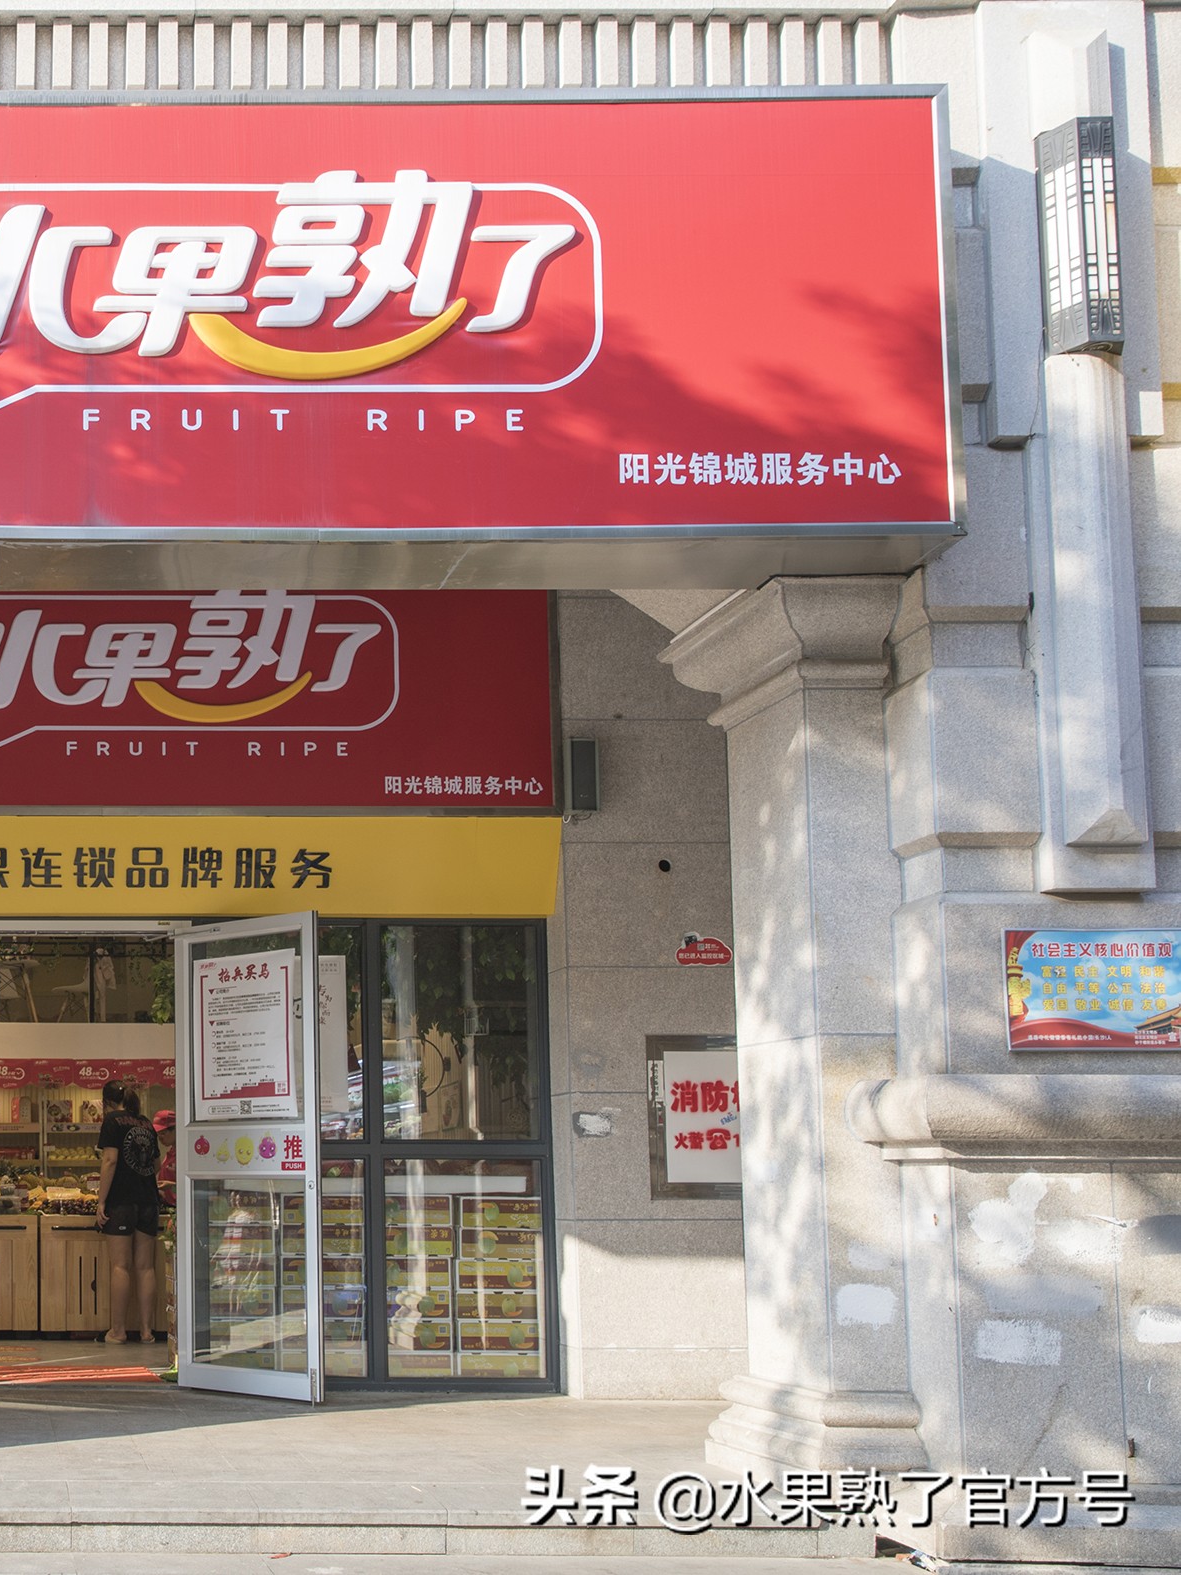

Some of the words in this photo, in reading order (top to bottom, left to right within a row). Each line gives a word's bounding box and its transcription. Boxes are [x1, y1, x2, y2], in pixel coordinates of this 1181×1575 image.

[82, 408, 290, 432] FRUIT
[367, 408, 525, 432] RIPE
[619, 452, 902, 486] 阳光锦城服务中心
[66, 740, 199, 757] FRUIT
[247, 740, 349, 757] RIPE
[384, 775, 543, 797] 阳光锦城服务中心
[1031, 942, 1172, 958] 社会主义核心价值观
[217, 963, 270, 984] 招兵买马
[1074, 965, 1099, 978] 民主
[1107, 966, 1132, 978] 文明
[1139, 965, 1165, 978] 和谐
[1042, 982, 1067, 995] 自由
[1074, 982, 1100, 995] 平等
[1107, 982, 1134, 995] 公正
[1140, 982, 1166, 995] 法治
[1043, 998, 1068, 1011] 爱国
[1075, 998, 1101, 1011] 敬业
[1108, 998, 1134, 1011] 诚信
[1141, 998, 1167, 1011] 友善
[283, 1134, 303, 1160] 推
[674, 1132, 705, 1151] 火警
